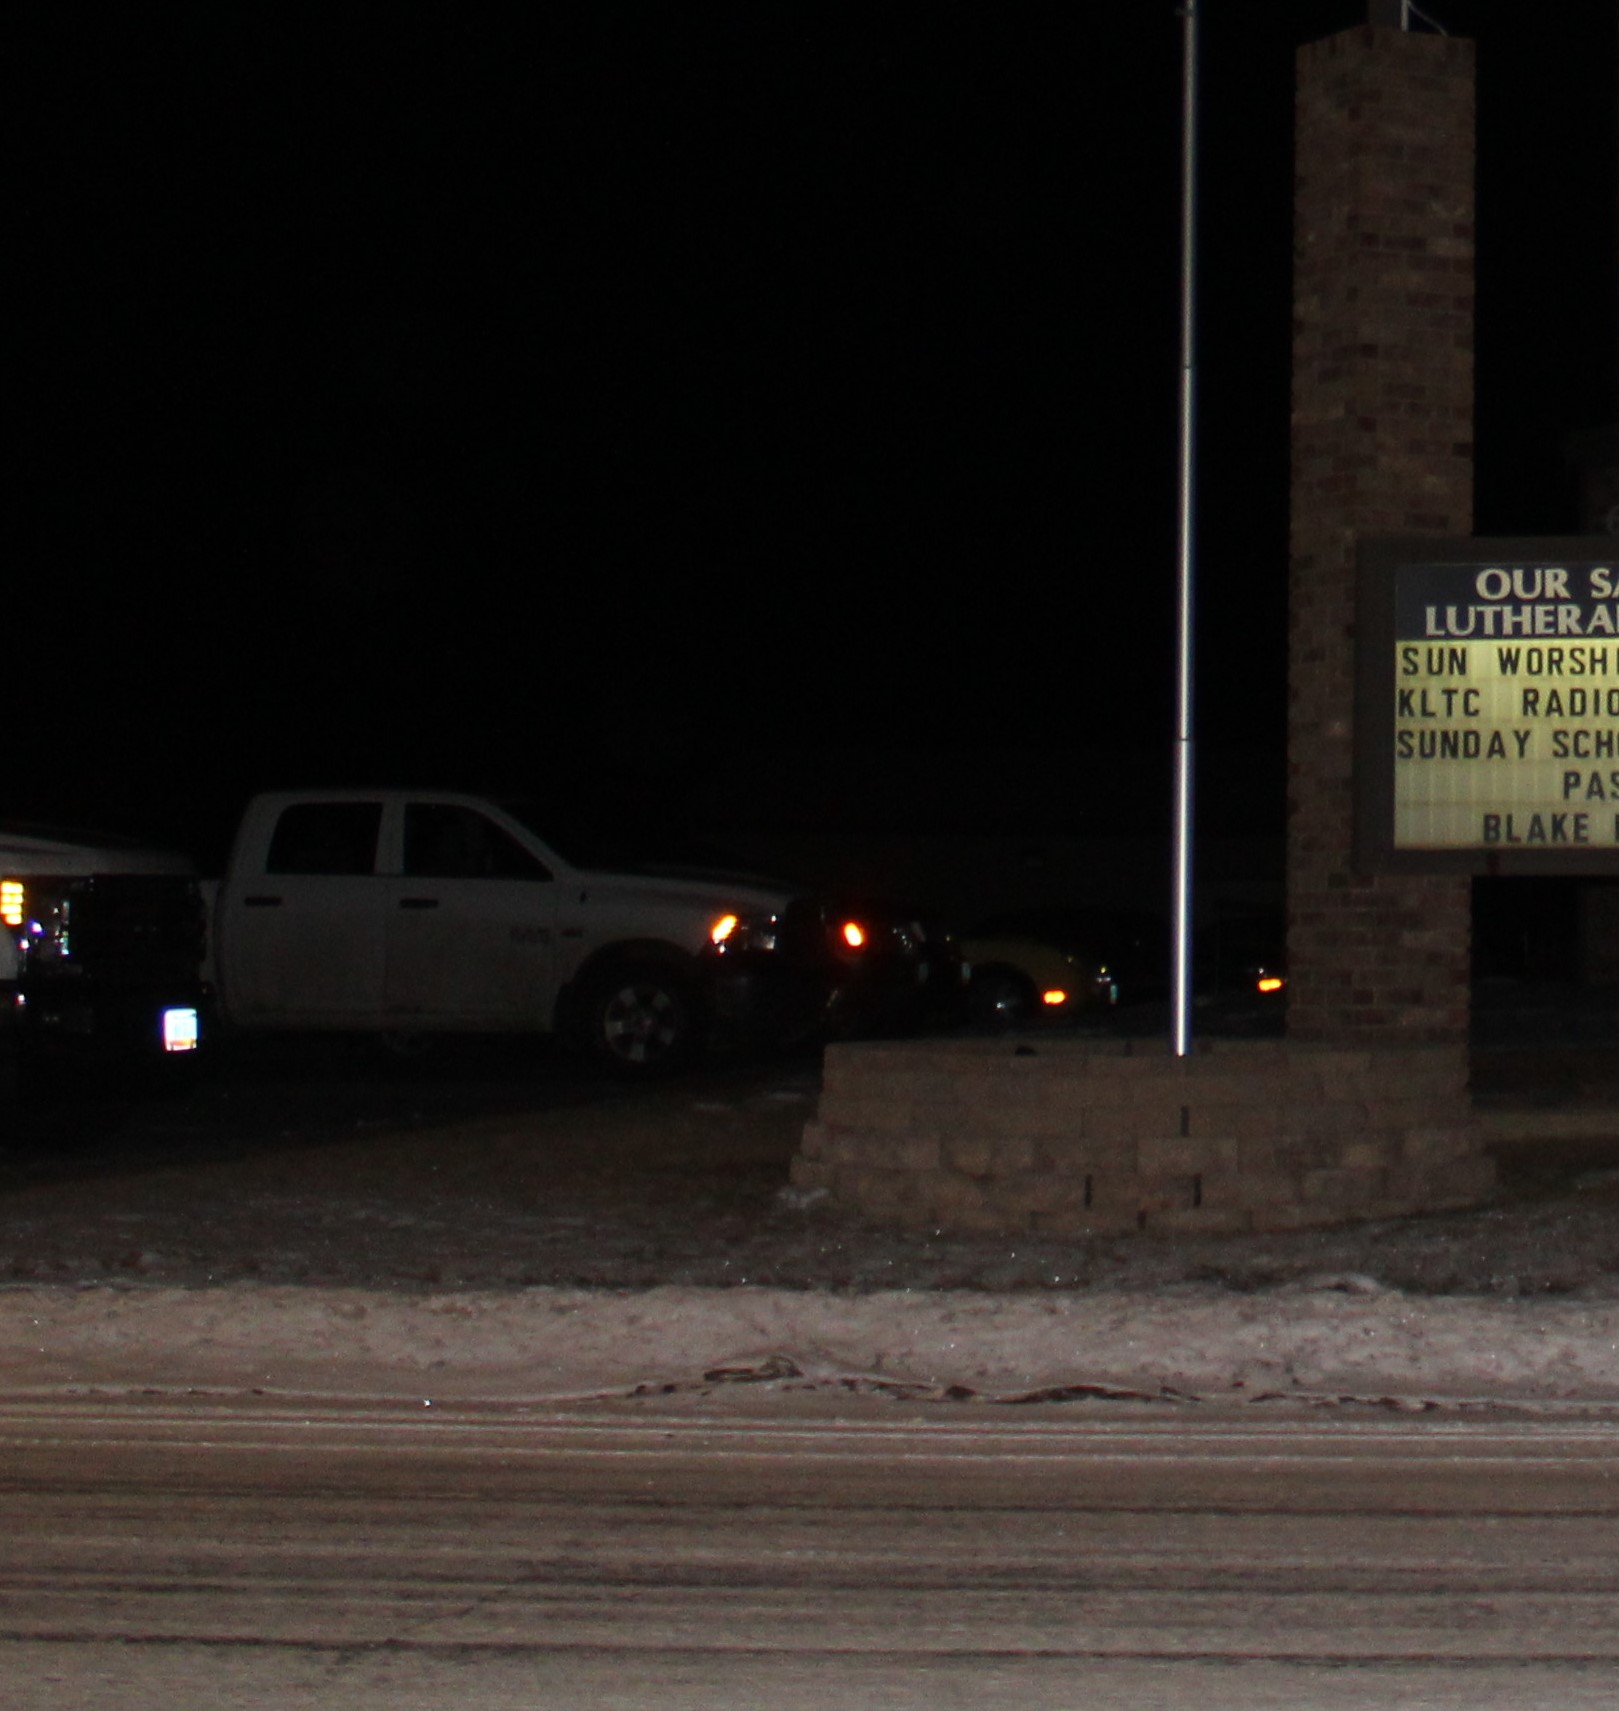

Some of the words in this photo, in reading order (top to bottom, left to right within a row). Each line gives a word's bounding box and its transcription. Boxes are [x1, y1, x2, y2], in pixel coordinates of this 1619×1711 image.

[1476, 568, 1572, 601] OUR
[1402, 647, 1468, 676] SUN
[1397, 689, 1481, 717] KLTC
[1397, 730, 1531, 760] SUNDAY
[1483, 814, 1588, 844] BLAKE
